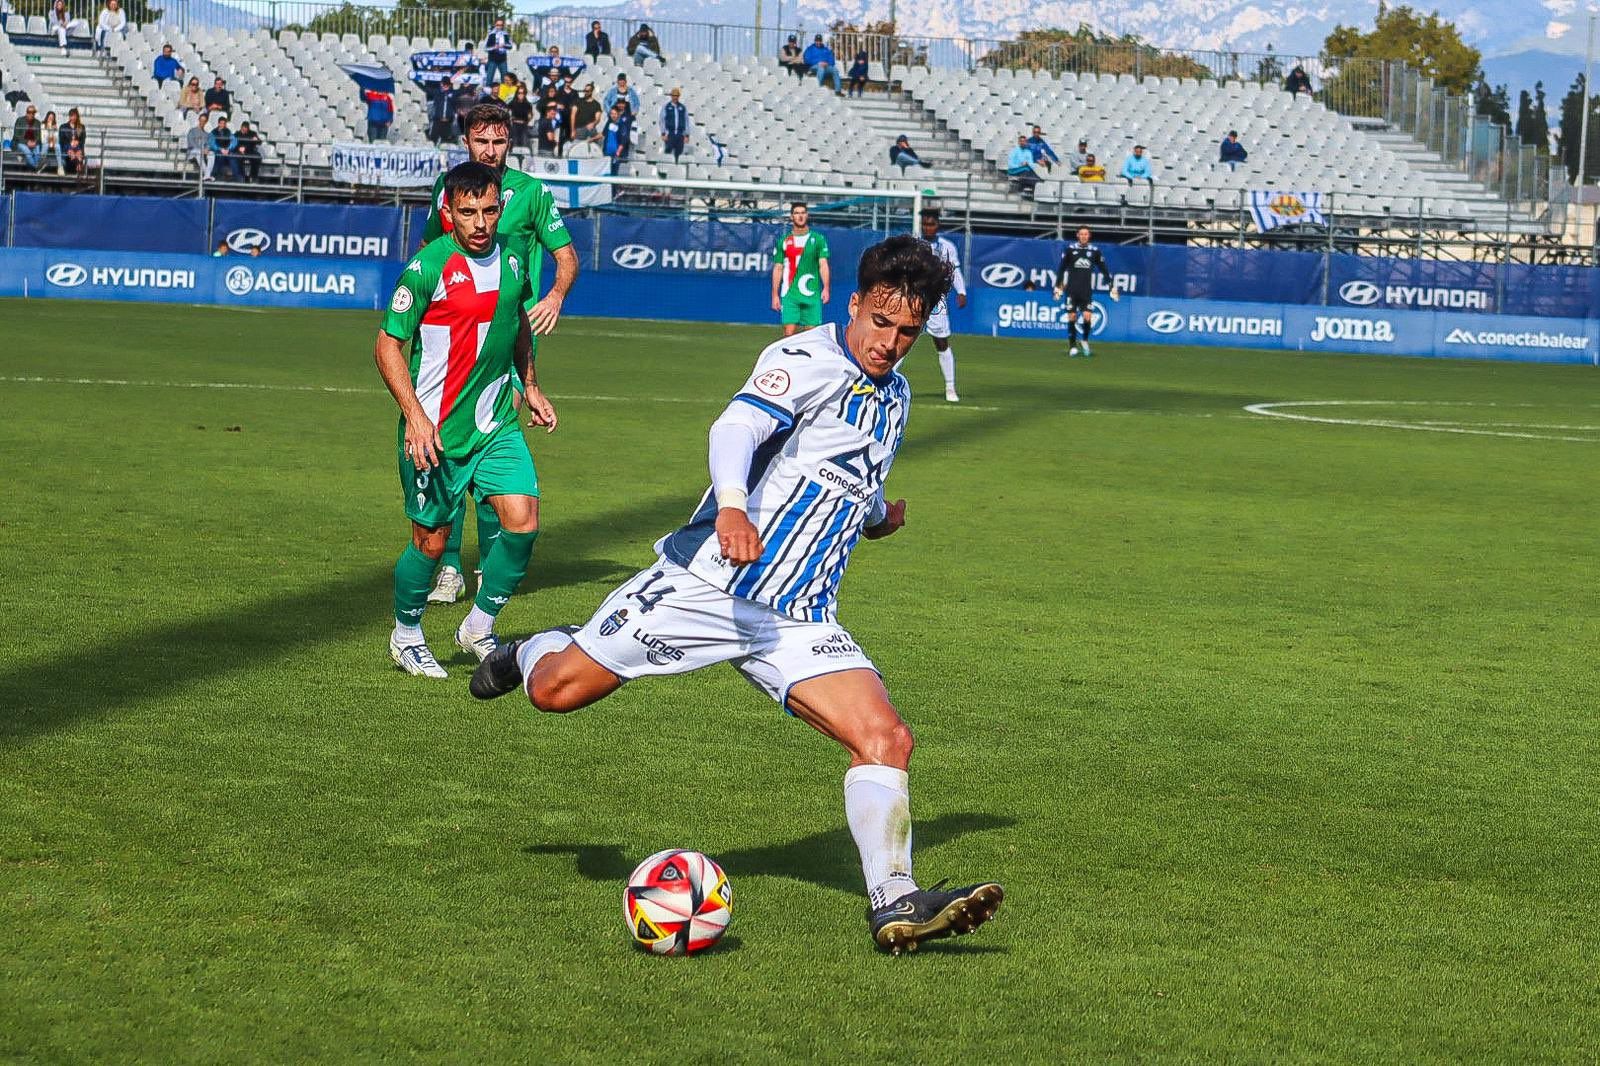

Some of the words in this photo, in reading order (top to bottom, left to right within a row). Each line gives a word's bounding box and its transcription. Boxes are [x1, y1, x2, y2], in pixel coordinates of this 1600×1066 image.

[276, 233, 389, 257] HYUNDAI
[661, 248, 768, 271] HYUNDAI
[92, 267, 195, 289] HYUNDAI
[255, 271, 356, 295] AGUILAR
[1385, 286, 1487, 309] HYUNDAI
[1189, 314, 1283, 337] HYUNDAI
[1477, 331, 1589, 349] conectabalear
[626, 570, 677, 615] 14
